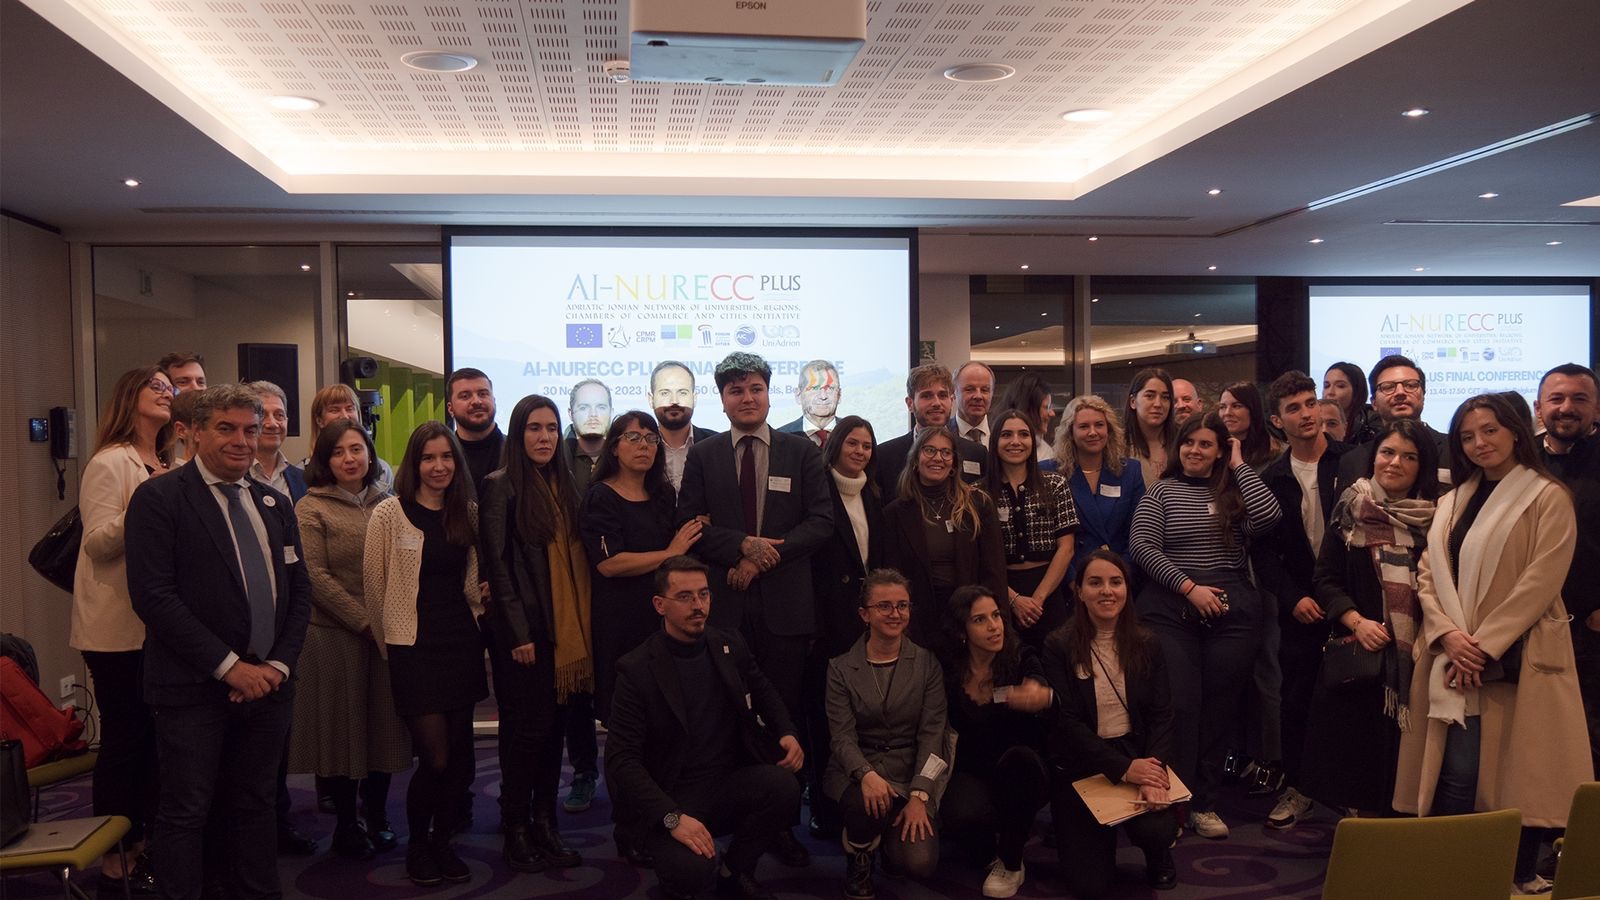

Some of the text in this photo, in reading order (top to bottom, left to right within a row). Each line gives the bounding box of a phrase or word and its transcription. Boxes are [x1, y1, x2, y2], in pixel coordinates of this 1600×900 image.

[735, 1, 766, 10] EPSON
[566, 273, 801, 301] AI-NURECC PLUS
[644, 303, 686, 311] NETWORK
[690, 303, 700, 311] OF
[565, 312, 801, 320] CHAMBERS OF COMMERCE AND CITIES INITIATIVE
[1380, 313, 1524, 332] AI-NURECC PLUS
[762, 339, 801, 347] UniAdrion
[523, 361, 624, 376] AI-NURECC
[1426, 370, 1545, 382] US FINAL CONFERENC
[543, 386, 558, 396] 30
[614, 385, 642, 396] 2023
